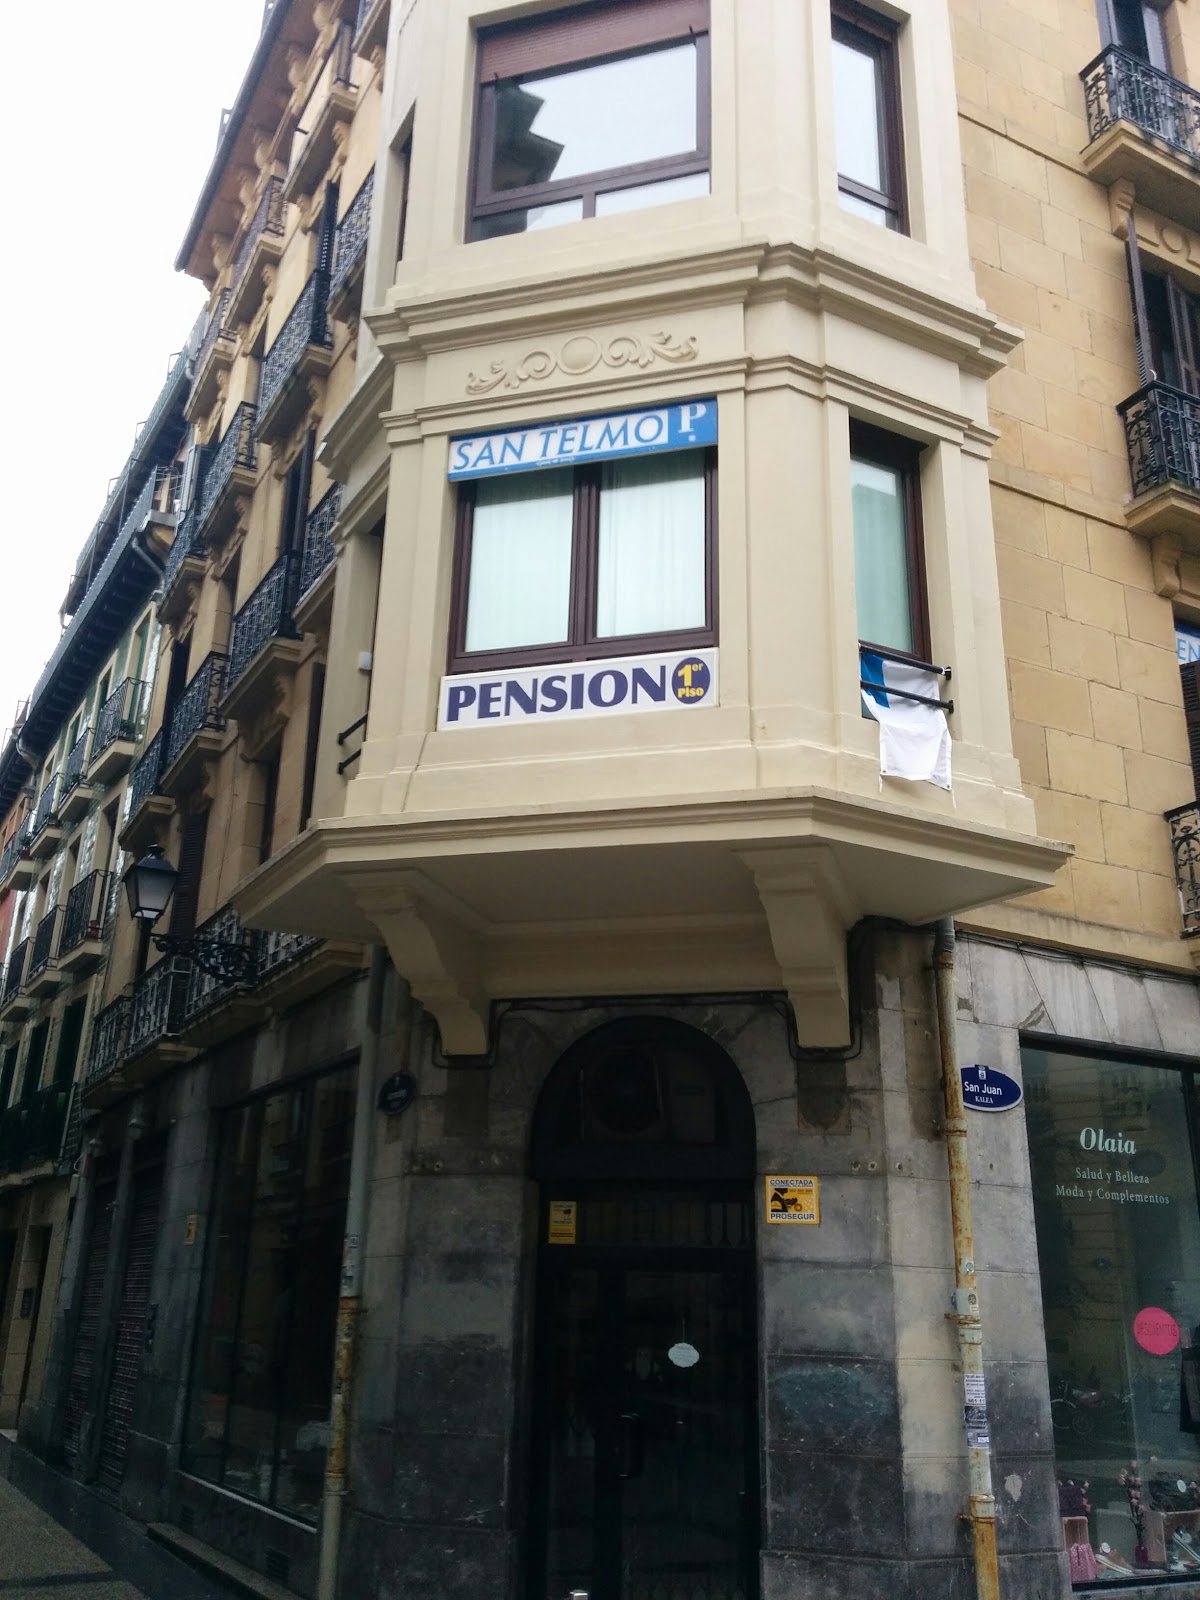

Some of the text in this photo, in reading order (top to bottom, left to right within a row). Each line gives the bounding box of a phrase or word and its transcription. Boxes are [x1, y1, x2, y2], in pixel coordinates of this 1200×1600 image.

[453, 414, 664, 470] SAN TELMO
[446, 665, 666, 722] PENSION
[964, 1081, 1003, 1096] San Juan
[975, 1095, 994, 1104] KALEA
[1080, 1127, 1137, 1155] Olaia
[1075, 1167, 1150, 1184] Salud y Belleza
[1056, 1184, 1170, 1204] Moda y Complementos
